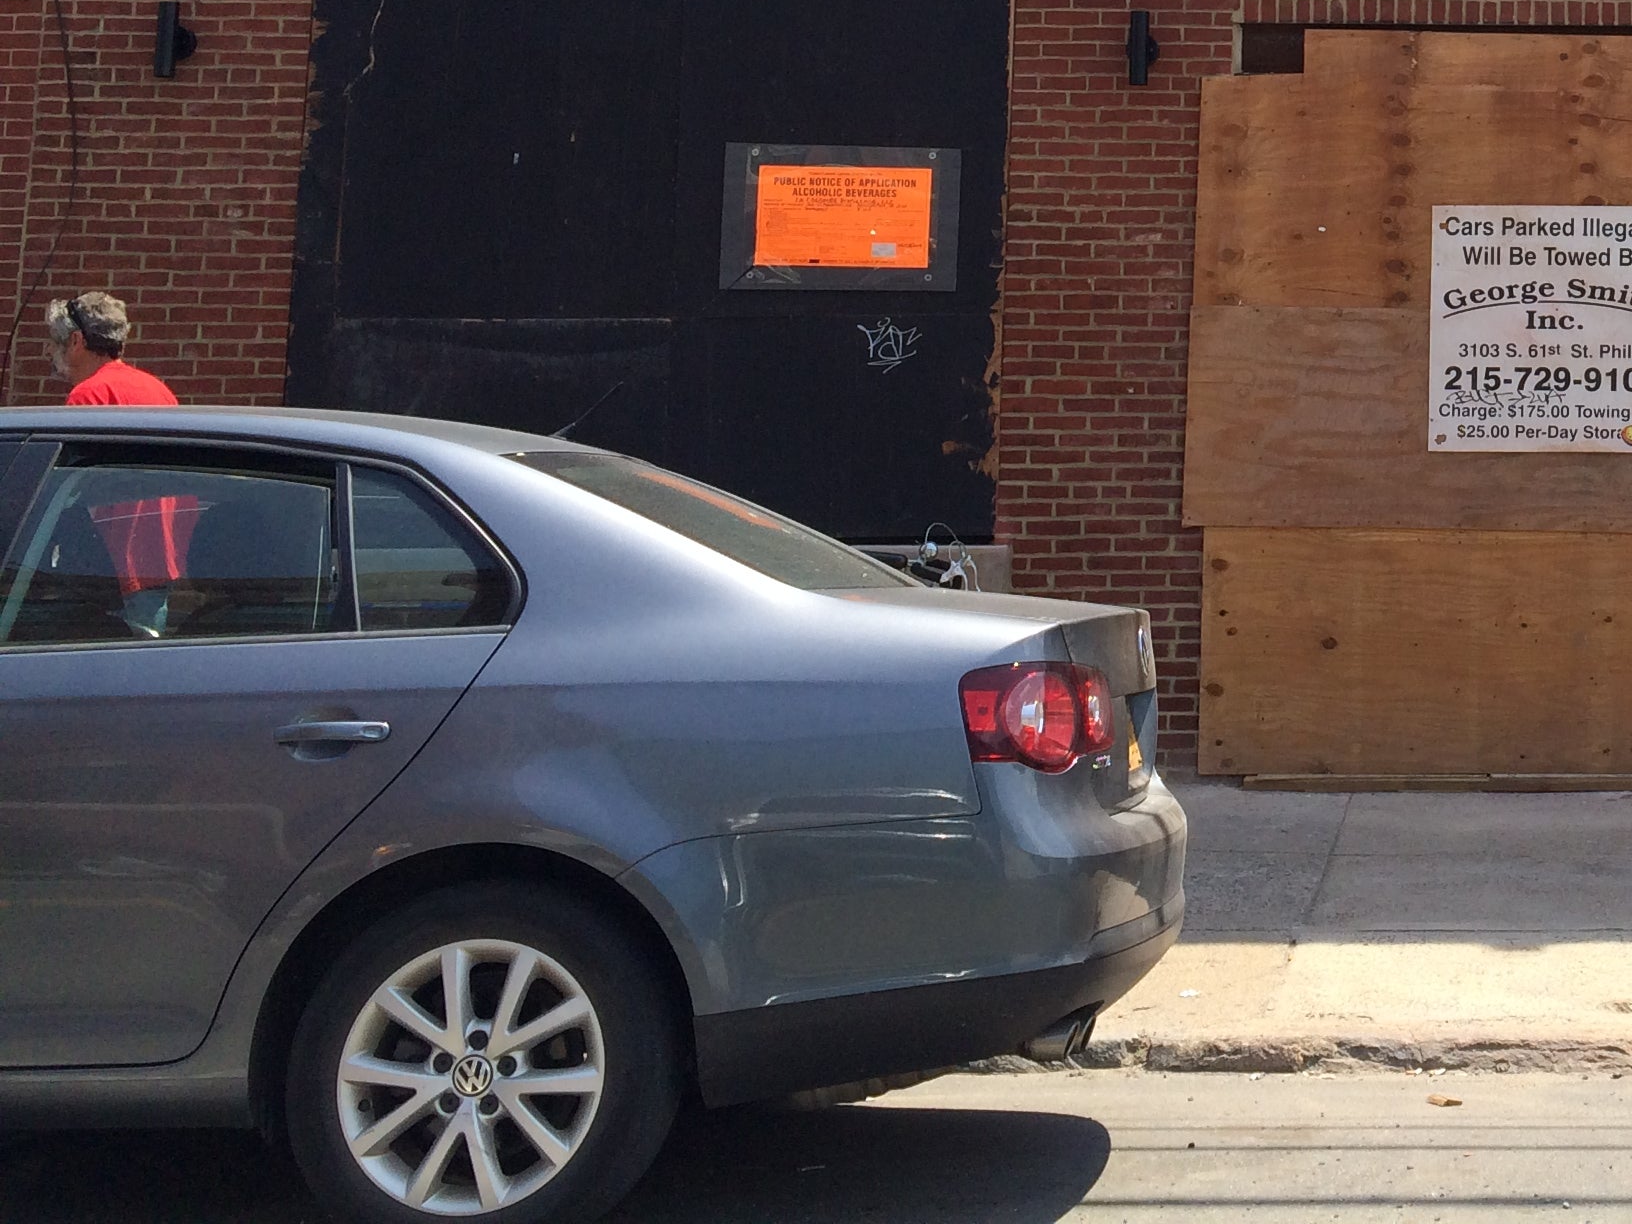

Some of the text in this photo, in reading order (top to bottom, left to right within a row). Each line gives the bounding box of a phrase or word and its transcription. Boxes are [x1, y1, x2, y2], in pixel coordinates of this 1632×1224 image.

[774, 177, 917, 188] PUBLIC NOTICE OF APPLICATION
[792, 187, 897, 198] ALCOHOLIC BEVERAGES
[1445, 216, 1494, 236] Cars
[1501, 217, 1575, 236] Parked
[1463, 246, 1501, 266] Will
[1509, 246, 1536, 266] Be
[1544, 247, 1611, 266] Towed
[1444, 279, 1554, 310] George
[1525, 310, 1583, 330] Inc.
[1458, 343, 1500, 358] 3103
[1506, 343, 1522, 358] S.
[1528, 344, 1561, 358] 61st
[1571, 344, 1593, 359] St.
[1438, 403, 1502, 421] Charge:
[1508, 404, 1570, 419] $175.00
[1575, 405, 1631, 422] Towing
[1457, 425, 1623, 442] $25.00 Per-Day Stora
